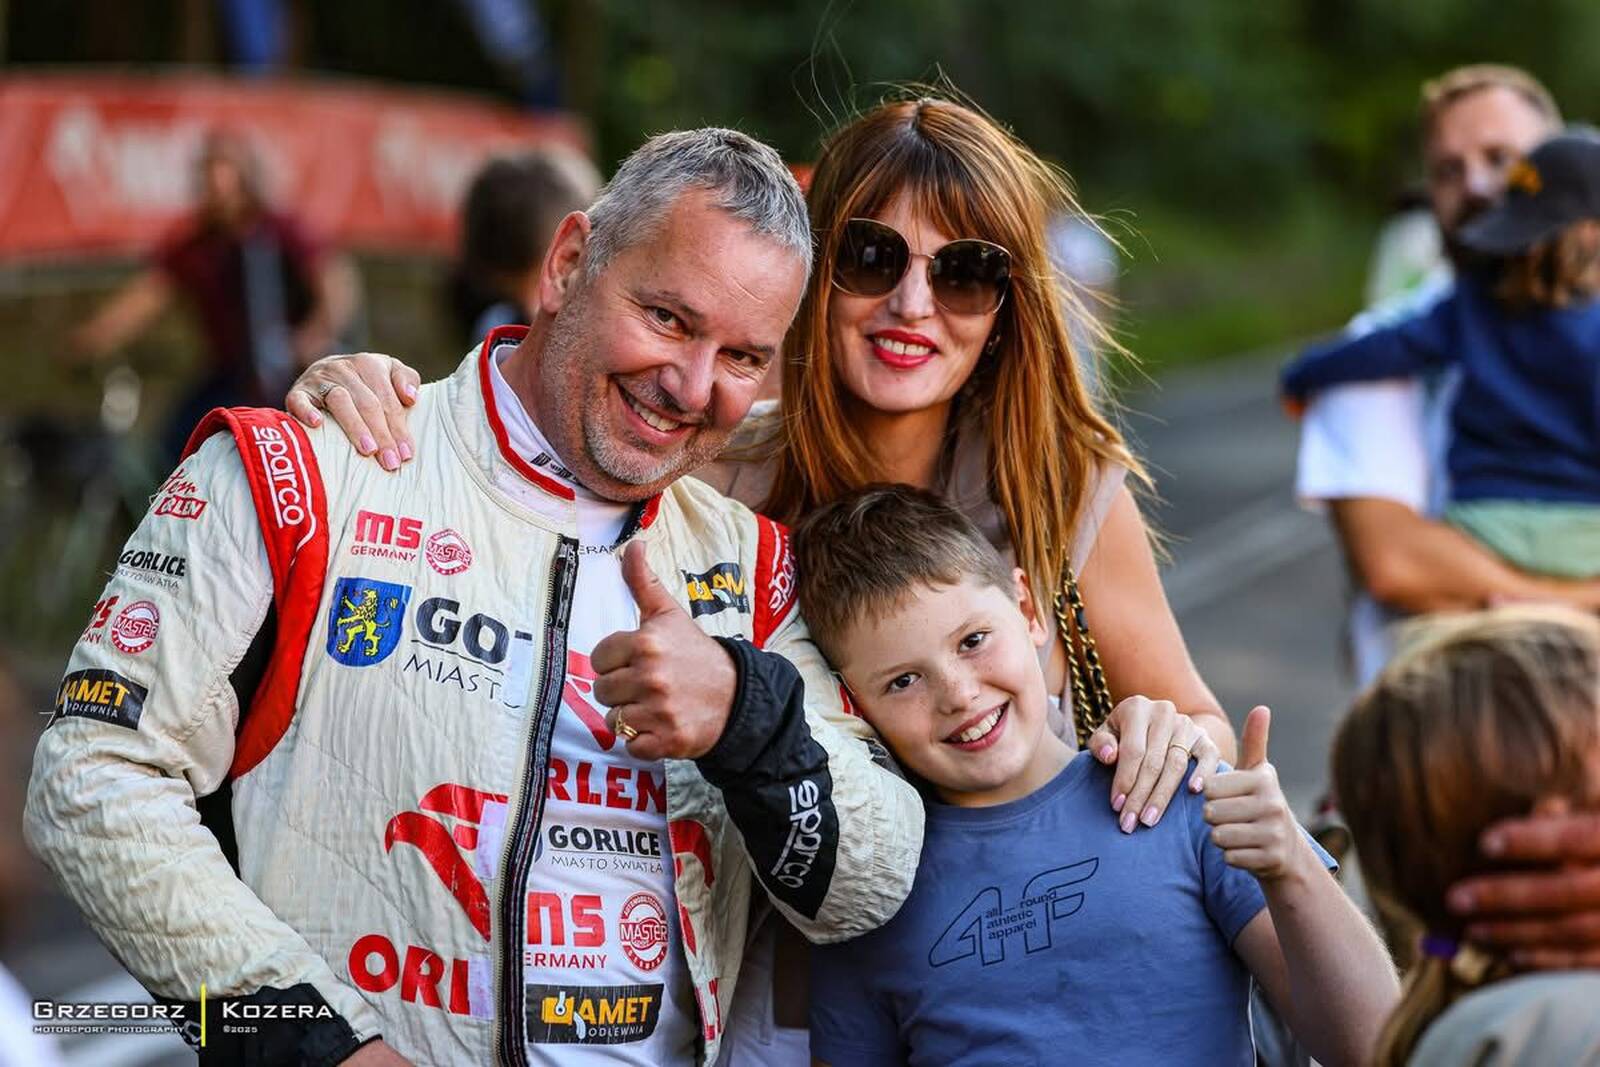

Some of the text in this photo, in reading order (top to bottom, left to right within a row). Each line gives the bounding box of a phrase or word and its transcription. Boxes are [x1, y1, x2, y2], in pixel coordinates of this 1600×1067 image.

[252, 424, 305, 529] sparco
[119, 549, 186, 577] GORLICE
[350, 544, 416, 562] GERMANY
[427, 540, 472, 566] MASTER
[115, 614, 158, 640] MASTER
[68, 703, 118, 718] DLEWNIA
[546, 758, 667, 814] RLEN
[550, 824, 661, 857] GORLICE
[774, 779, 823, 889] sparco
[551, 856, 607, 870] MIASTO
[1020, 890, 1057, 909] round
[928, 857, 1099, 967] 4F
[986, 909, 1034, 930] athletic
[620, 922, 668, 942] MASTER
[988, 917, 1037, 940] apparel
[524, 952, 608, 969] ERMANY
[588, 1025, 644, 1038] ODLEWNIA
